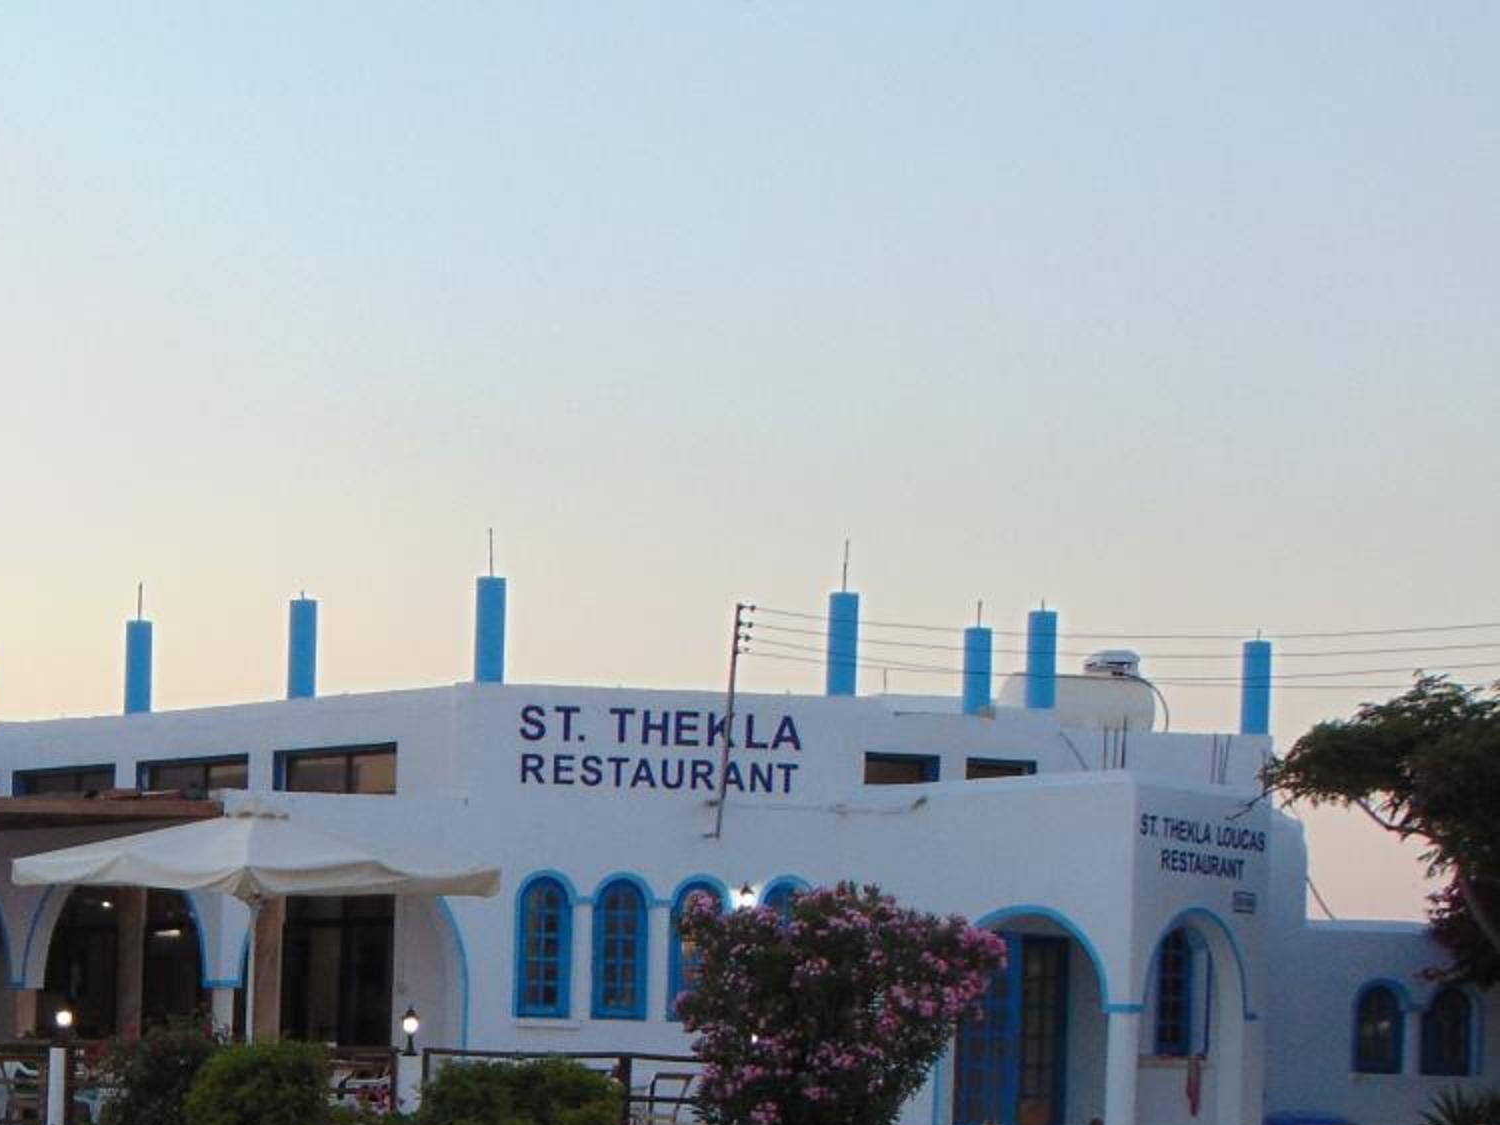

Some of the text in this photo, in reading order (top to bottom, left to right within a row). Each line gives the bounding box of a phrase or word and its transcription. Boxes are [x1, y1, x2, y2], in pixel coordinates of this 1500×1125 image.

[519, 705, 801, 750] ST. THEKLA
[520, 753, 799, 793] RESTAURANT
[1140, 813, 1266, 852] ST. THEKLA LOUCAS
[1160, 849, 1245, 880] RESTAURANT
